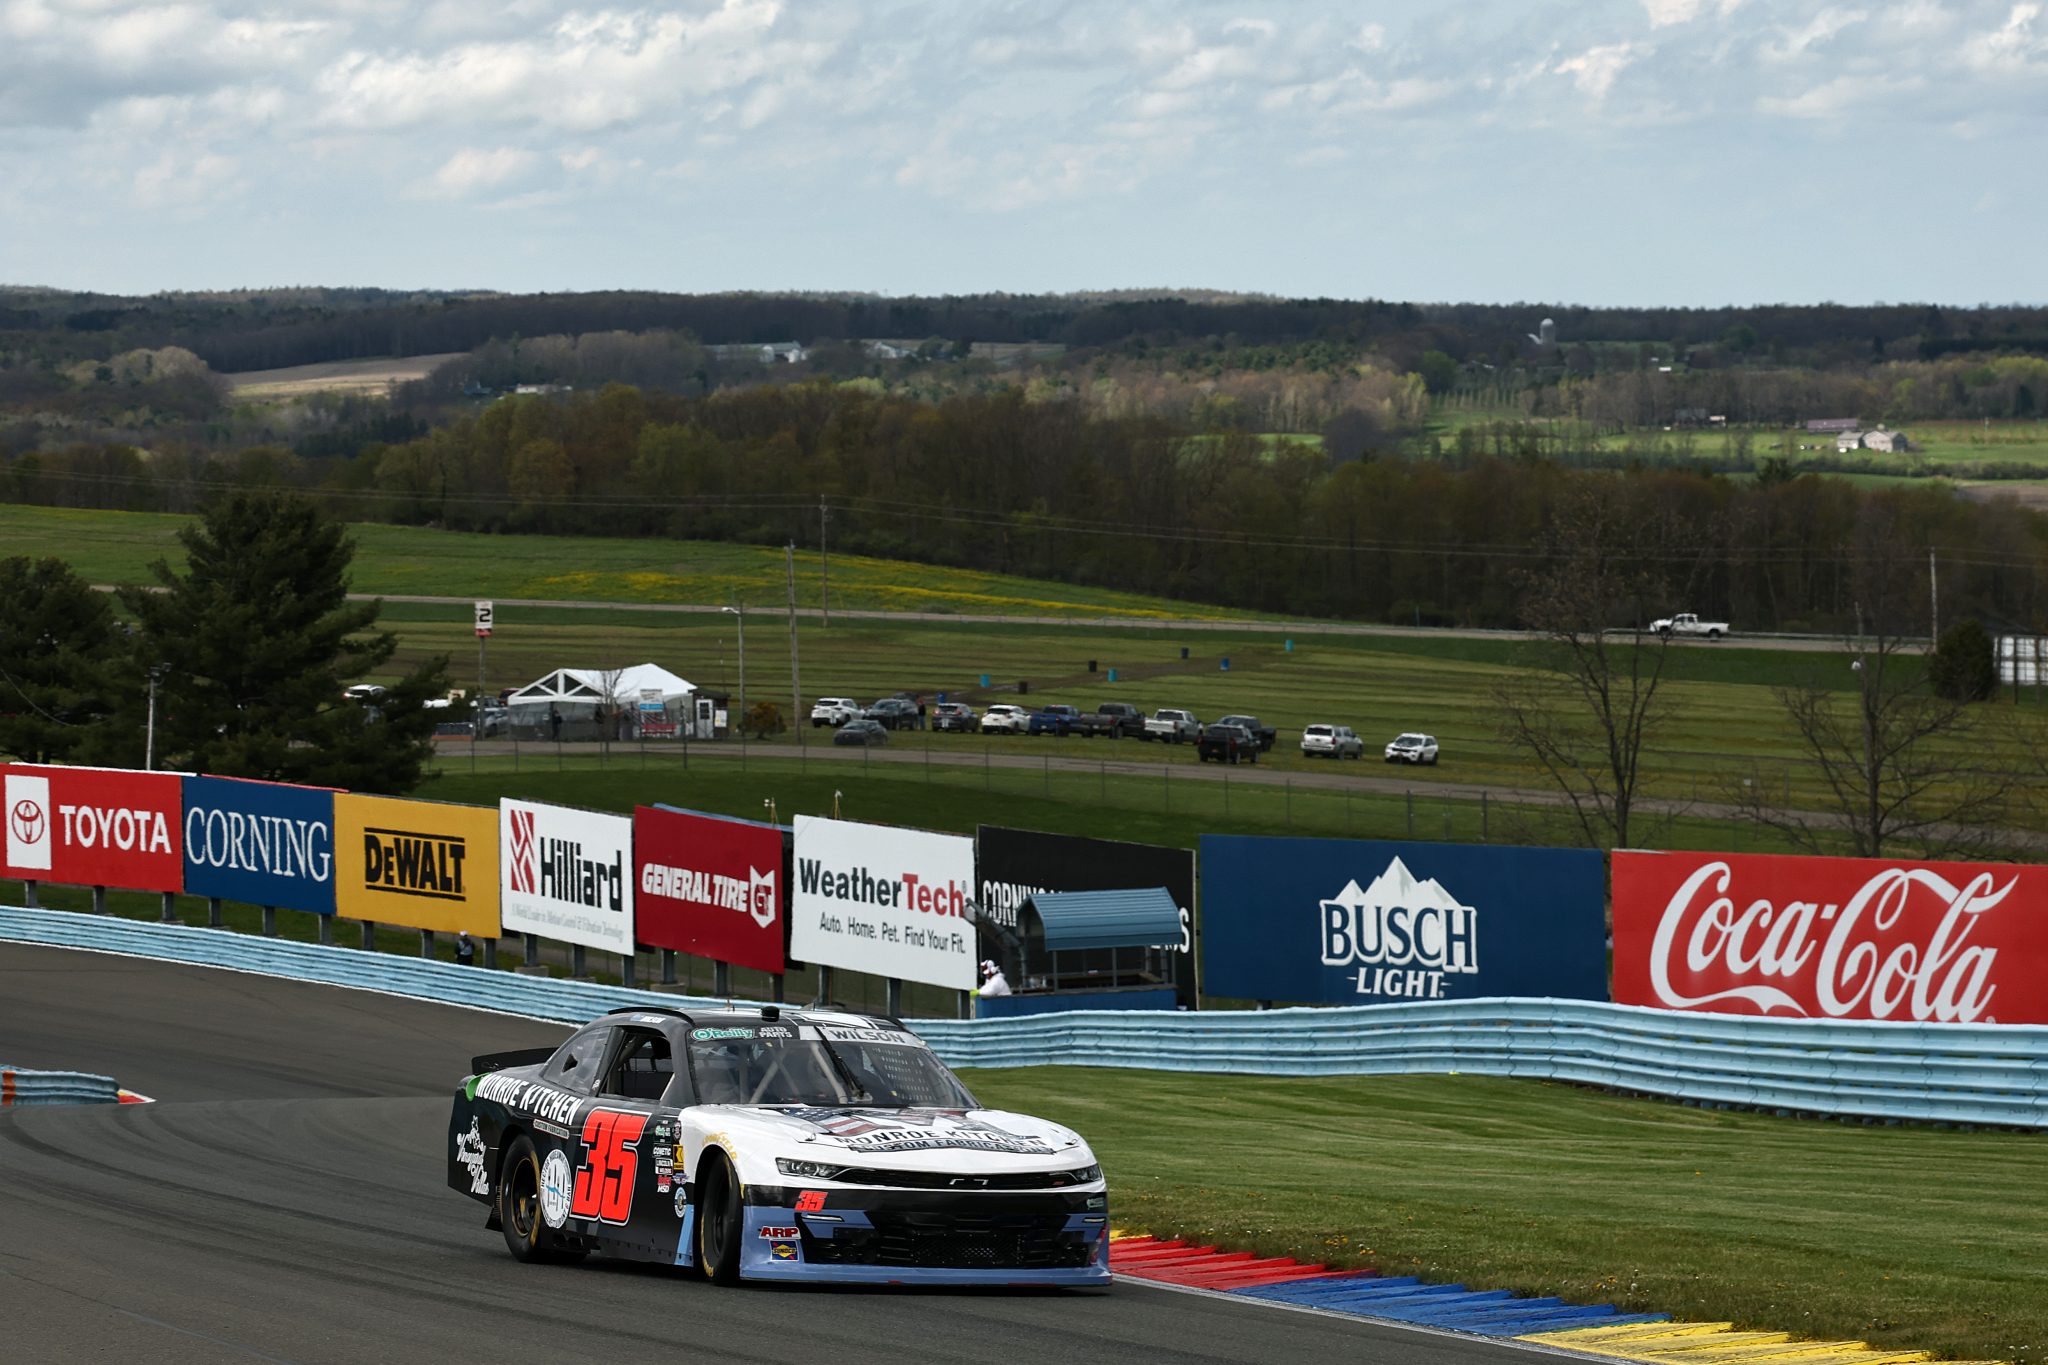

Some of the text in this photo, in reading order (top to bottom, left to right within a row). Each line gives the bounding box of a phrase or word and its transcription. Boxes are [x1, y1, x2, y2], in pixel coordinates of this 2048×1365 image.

[480, 608, 491, 622] 2
[59, 804, 172, 854] TOYOTA
[186, 806, 331, 882] CORNING
[540, 836, 623, 912] Hilliard
[642, 863, 749, 912] GENERAL TIRE
[799, 857, 965, 918] WeatherTech
[819, 912, 966, 953] Auto. Home. Pet. Find Your Fit.
[1322, 901, 1477, 972] BUSCH
[1651, 861, 2018, 1023] Coca-Cola
[1356, 967, 1444, 998] LIGHT
[692, 1027, 755, 1039] O'Reilly
[830, 1029, 905, 1043] WILSON
[475, 1073, 529, 1106] MONROE
[520, 1084, 584, 1126] KITCHEN
[834, 1130, 1047, 1146] MONROE KITCHEN
[570, 1107, 651, 1225] 35
[657, 1185, 670, 1193] MSD
[795, 1191, 827, 1212] 35
[760, 1227, 799, 1238] ARP
